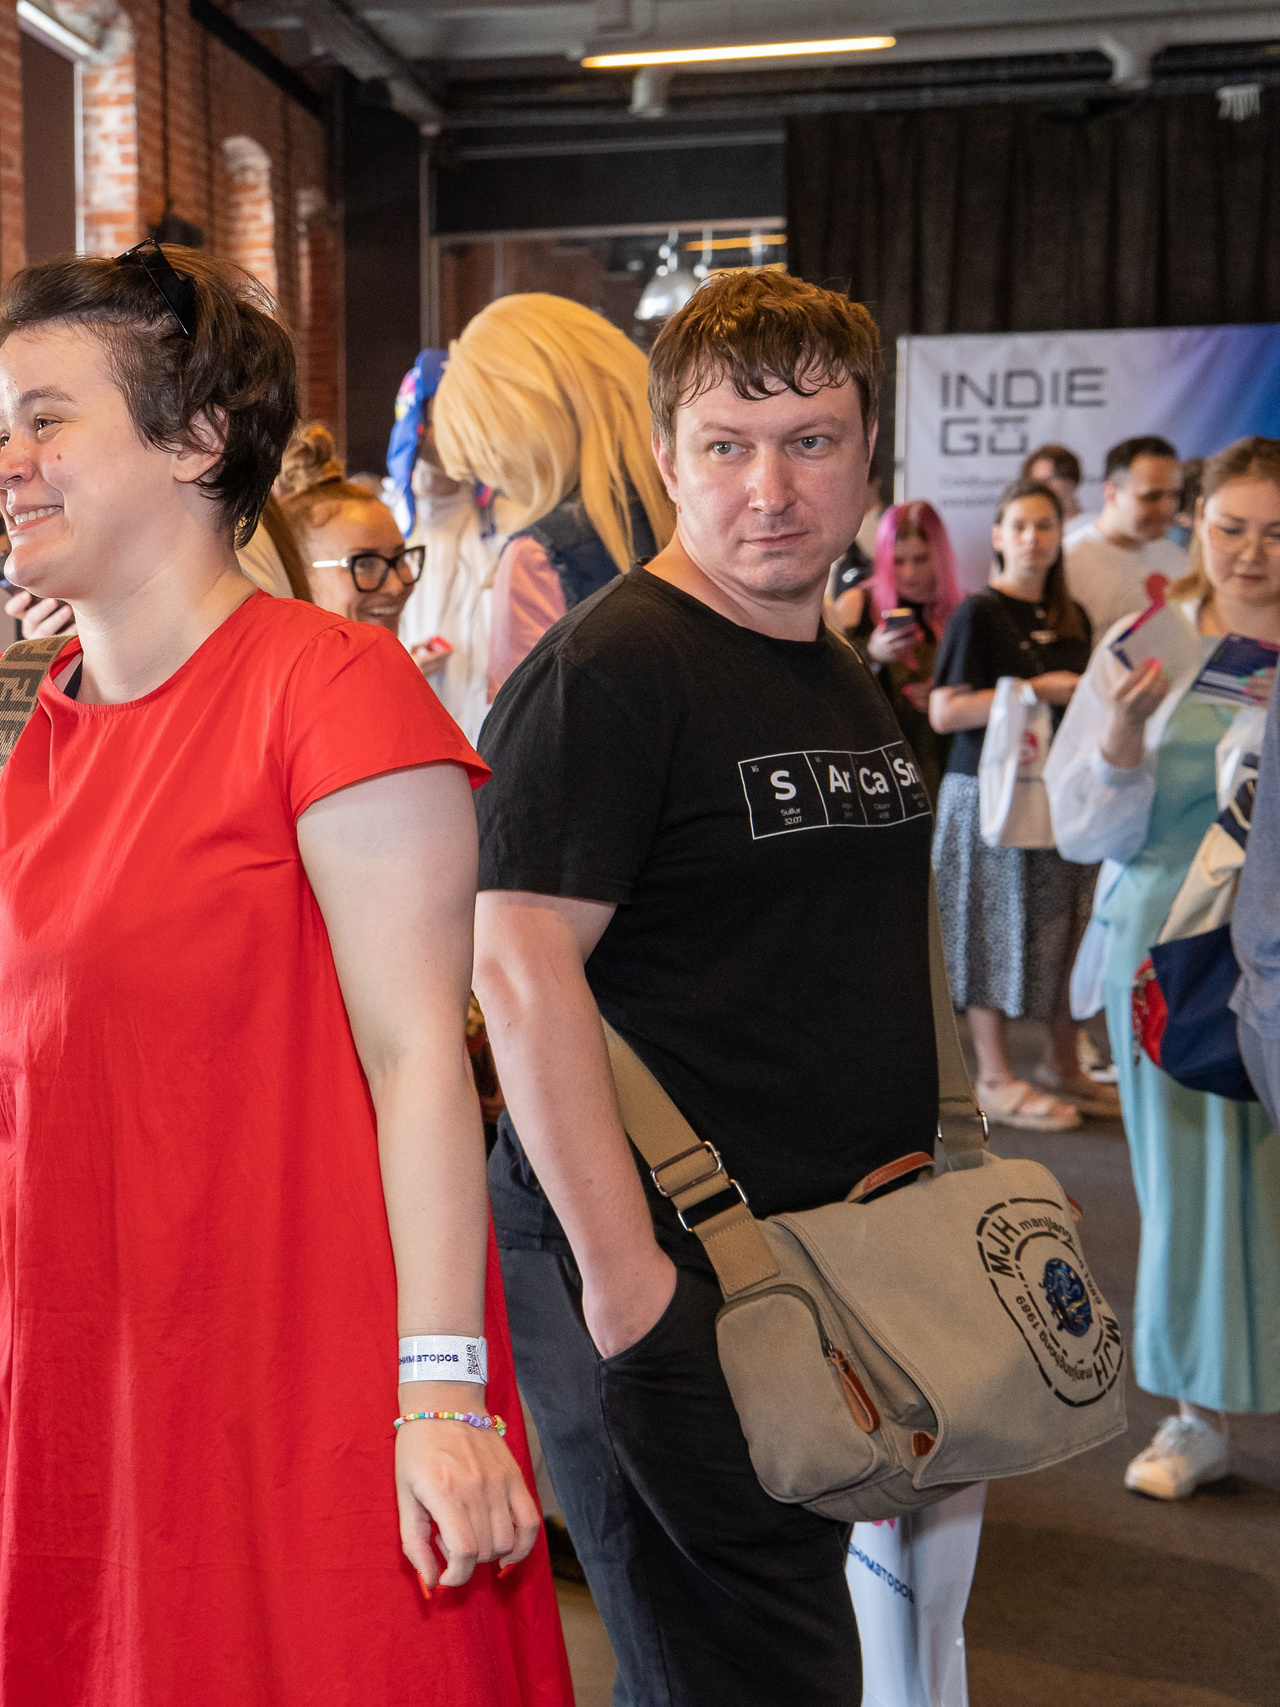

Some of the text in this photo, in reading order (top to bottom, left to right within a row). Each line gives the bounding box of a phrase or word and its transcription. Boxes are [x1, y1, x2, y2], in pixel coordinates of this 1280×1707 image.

[941, 367, 1107, 412] INDIE
[770, 770, 797, 800] S
[828, 764, 852, 793] Ar
[859, 767, 890, 795] Ca
[986, 1215, 1021, 1279] MJH
[1015, 1295, 1040, 1330] 1989
[399, 1353, 459, 1365] ниматоров
[1093, 1315, 1121, 1388] MJH
